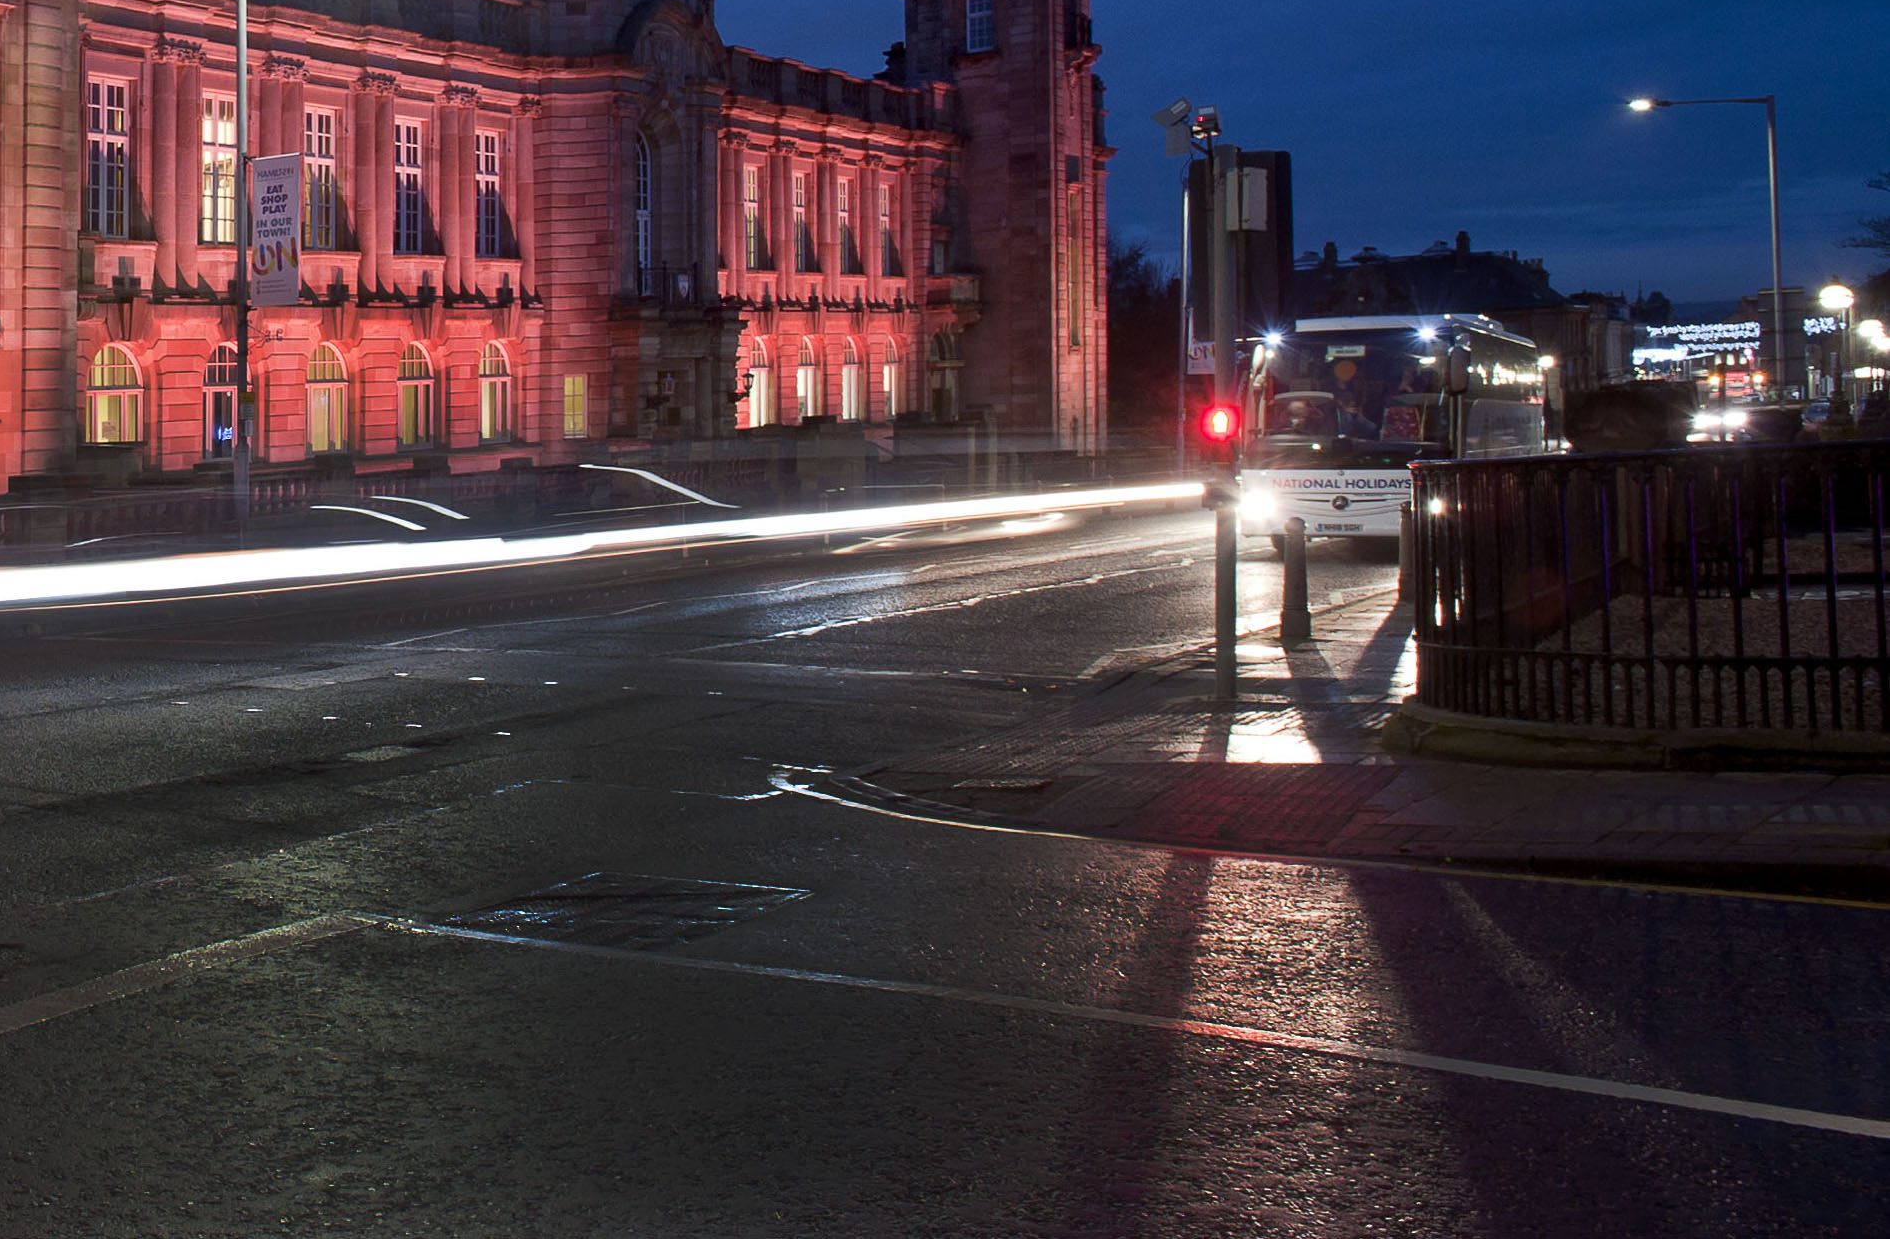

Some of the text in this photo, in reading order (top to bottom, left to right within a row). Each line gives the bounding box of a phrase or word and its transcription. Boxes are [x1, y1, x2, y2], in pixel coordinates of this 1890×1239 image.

[266, 184, 284, 195] EAT
[260, 194, 289, 206] SHOP
[262, 204, 287, 215] PLAY
[256, 217, 293, 229] IN OUR
[257, 228, 291, 238] TOWN!
[1271, 478, 1412, 489] NATIONAL HOLIDAYS
